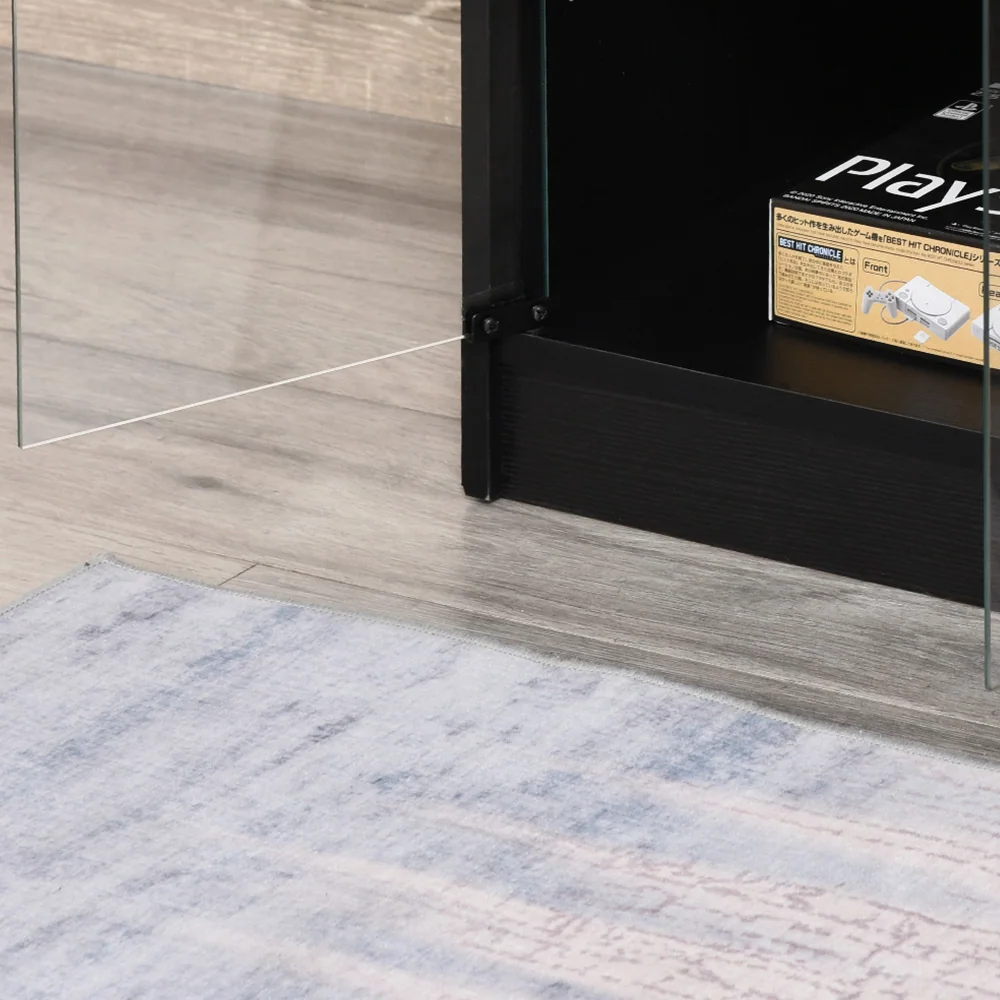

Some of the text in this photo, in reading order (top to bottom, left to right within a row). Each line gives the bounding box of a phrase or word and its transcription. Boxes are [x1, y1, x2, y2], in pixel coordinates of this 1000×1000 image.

[780, 237, 795, 249] BEST
[796, 240, 807, 252] HIT
[807, 244, 842, 259] CHRONICLE
[908, 241, 922, 250] HIT
[864, 261, 888, 273] Front
